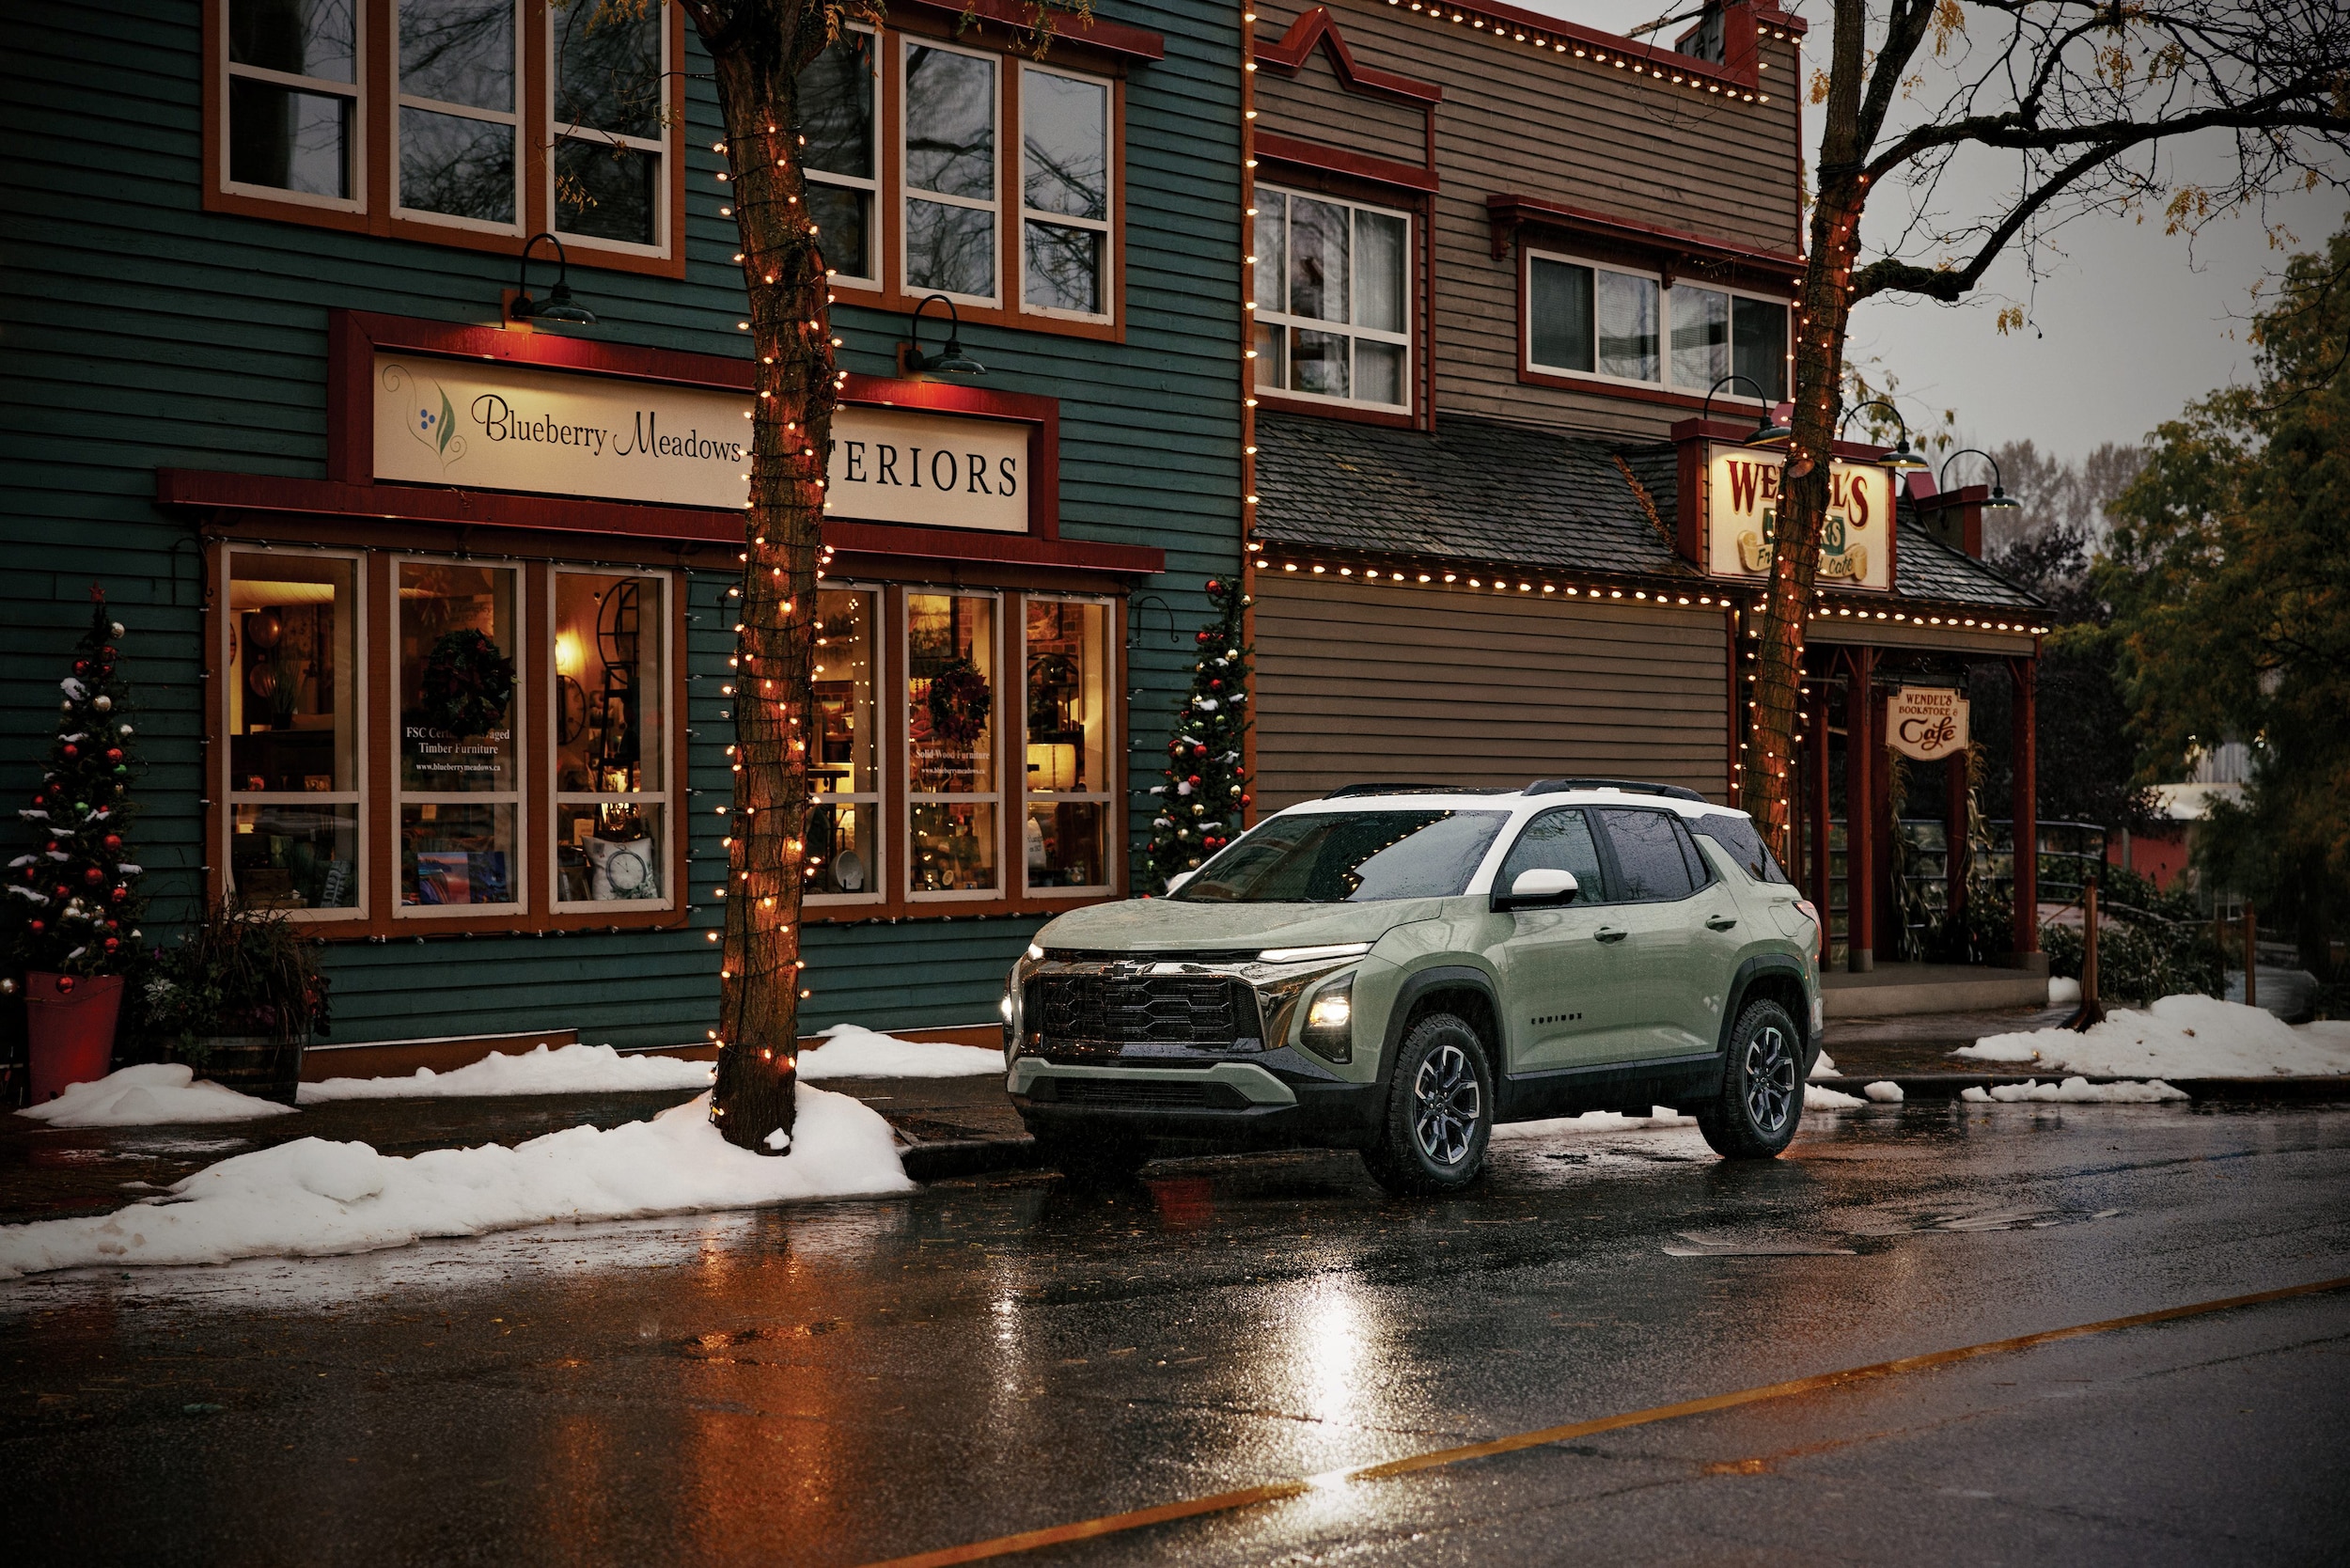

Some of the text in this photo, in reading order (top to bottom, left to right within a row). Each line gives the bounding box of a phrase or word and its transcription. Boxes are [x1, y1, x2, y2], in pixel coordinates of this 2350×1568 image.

[471, 394, 1016, 497] Blueberry Meadows ERIORS
[1726, 460, 1869, 527] WEL'S
[1906, 694, 1952, 706] WENDEL'S
[1899, 706, 1950, 715] BOOKSTORE
[406, 727, 427, 739] FSC
[418, 742, 498, 754] Timber Furniture
[957, 750, 990, 760] Furniture
[416, 762, 501, 773] www.blueberrymeadows.ca
